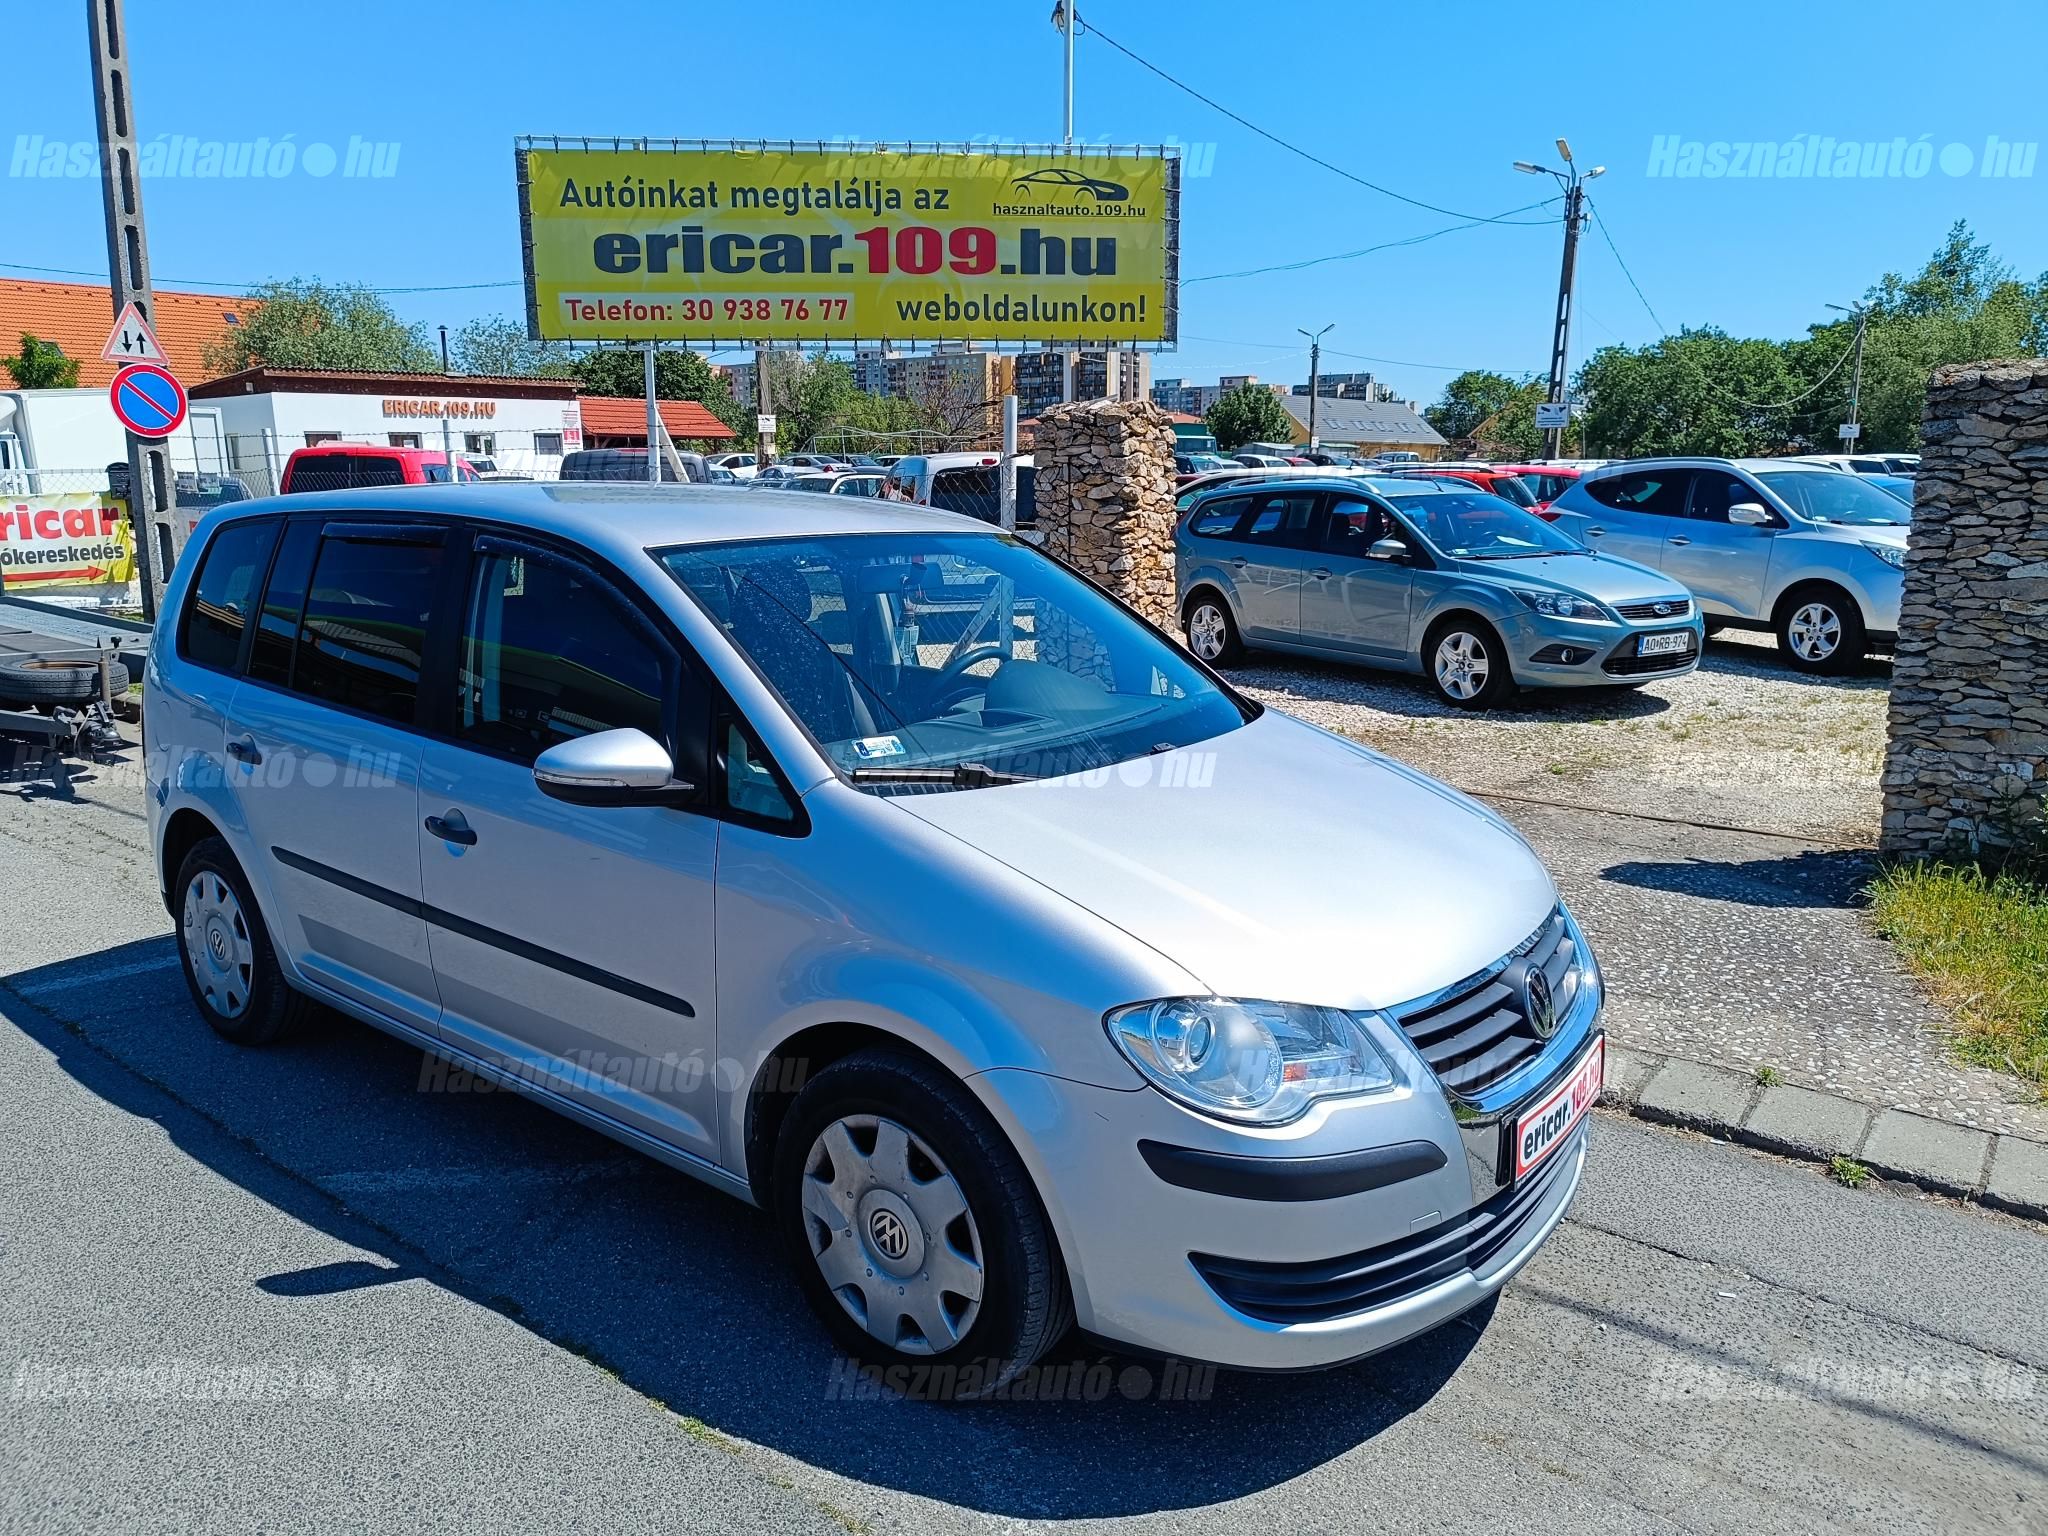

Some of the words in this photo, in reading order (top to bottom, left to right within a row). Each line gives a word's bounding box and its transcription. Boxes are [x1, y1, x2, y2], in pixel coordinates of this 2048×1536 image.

[559, 175, 718, 208] Autóinkat
[731, 176, 901, 217] megtalálja
[913, 189, 949, 210] az
[992, 202, 1146, 217] hasznaltauto.109.hu
[593, 225, 1117, 276] ericar.109.hu
[565, 299, 673, 321] Telefon:
[682, 299, 713, 321] 30
[723, 299, 771, 321] 938
[780, 299, 809, 321] 76
[819, 299, 848, 321] 77
[896, 294, 1145, 322] weboldalunkon!
[382, 399, 496, 419] ERICAR.109.HU
